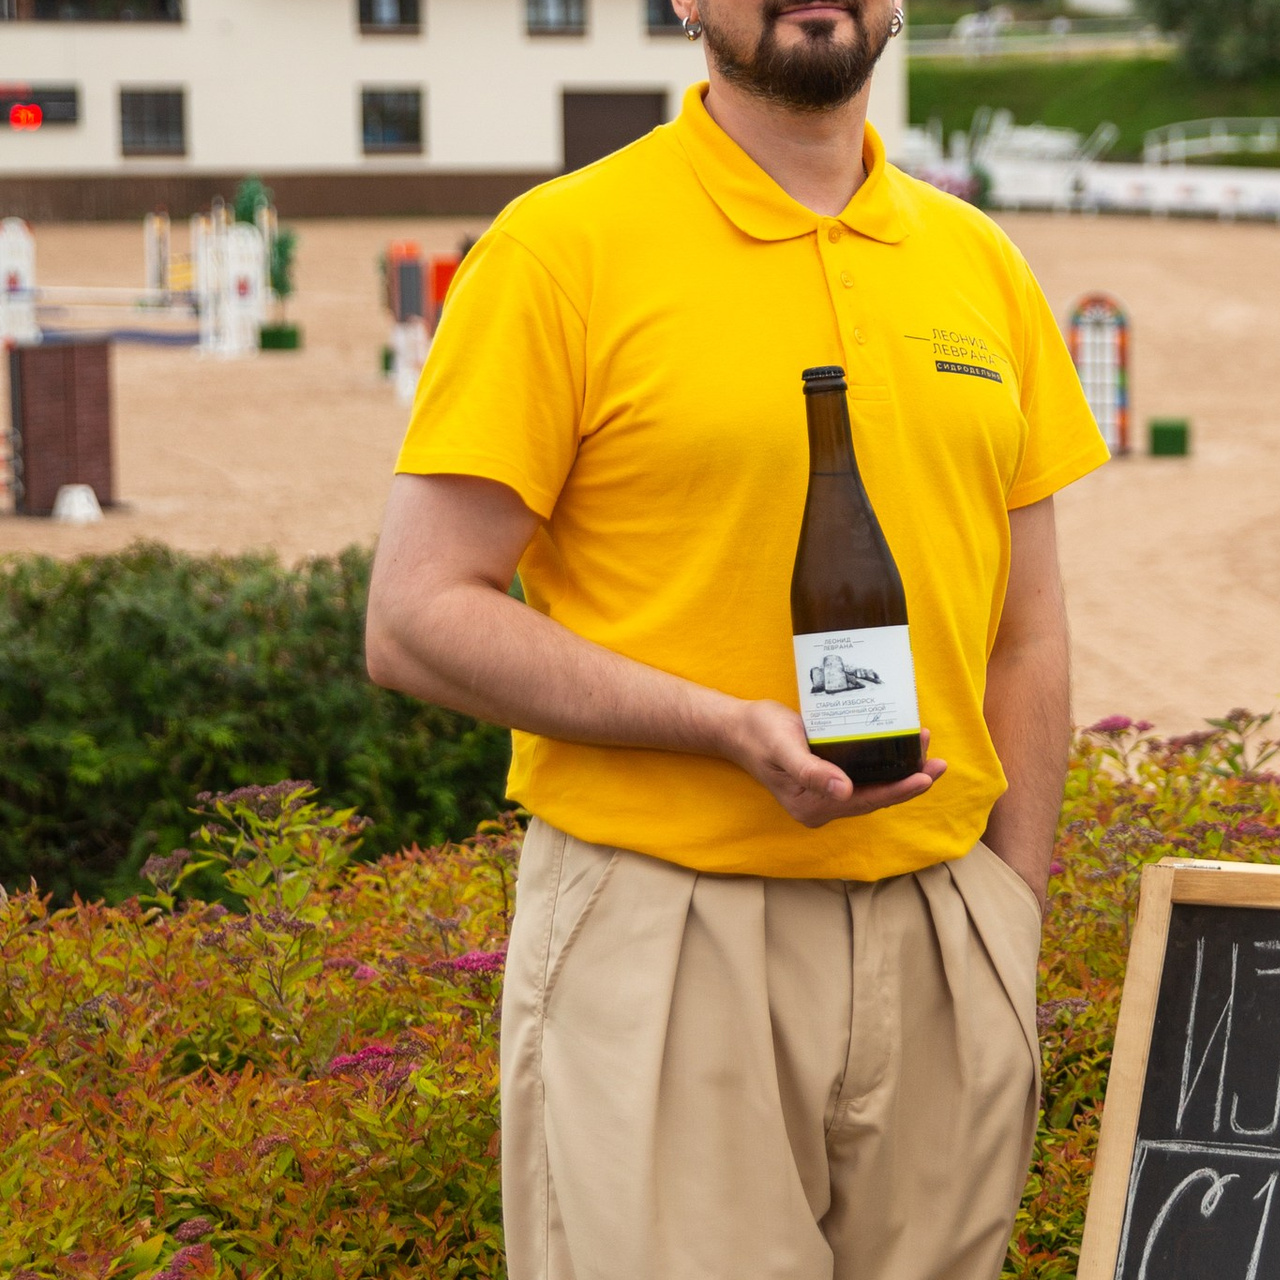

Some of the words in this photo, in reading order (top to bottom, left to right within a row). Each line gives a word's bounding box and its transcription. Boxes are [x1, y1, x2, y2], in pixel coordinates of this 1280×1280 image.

[932, 328, 989, 351] ЛЕОНИД
[932, 343, 996, 365] ЛЕВРАНА
[842, 698, 876, 706] ИЗБОРСК
